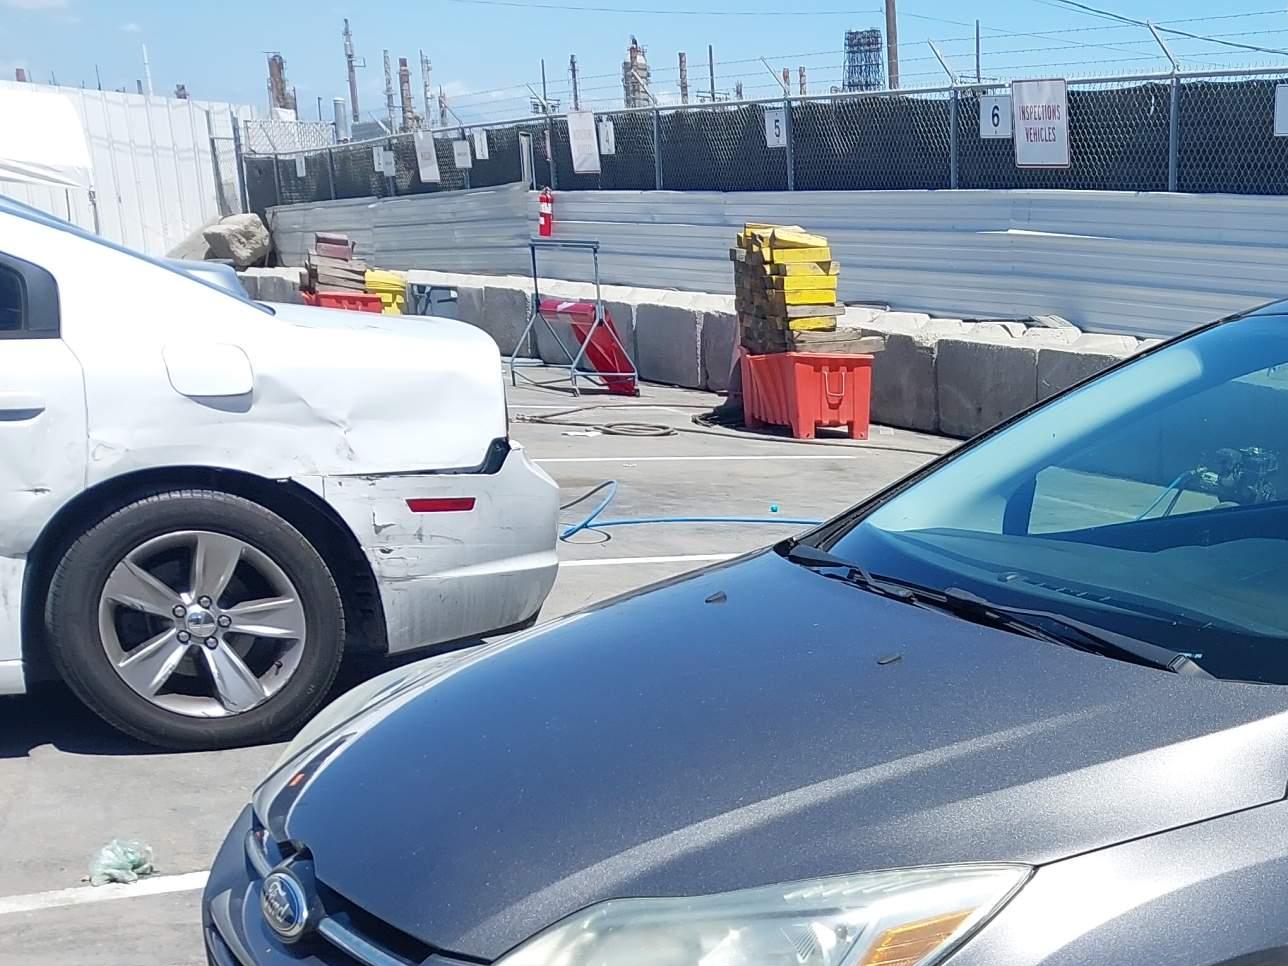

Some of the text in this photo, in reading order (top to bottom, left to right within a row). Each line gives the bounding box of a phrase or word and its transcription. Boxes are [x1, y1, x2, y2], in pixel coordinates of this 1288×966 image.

[991, 105, 1000, 128] 6
[1019, 104, 1061, 121] INSPECTIONS
[774, 119, 781, 138] 5
[1025, 126, 1057, 143] VEHICLES
